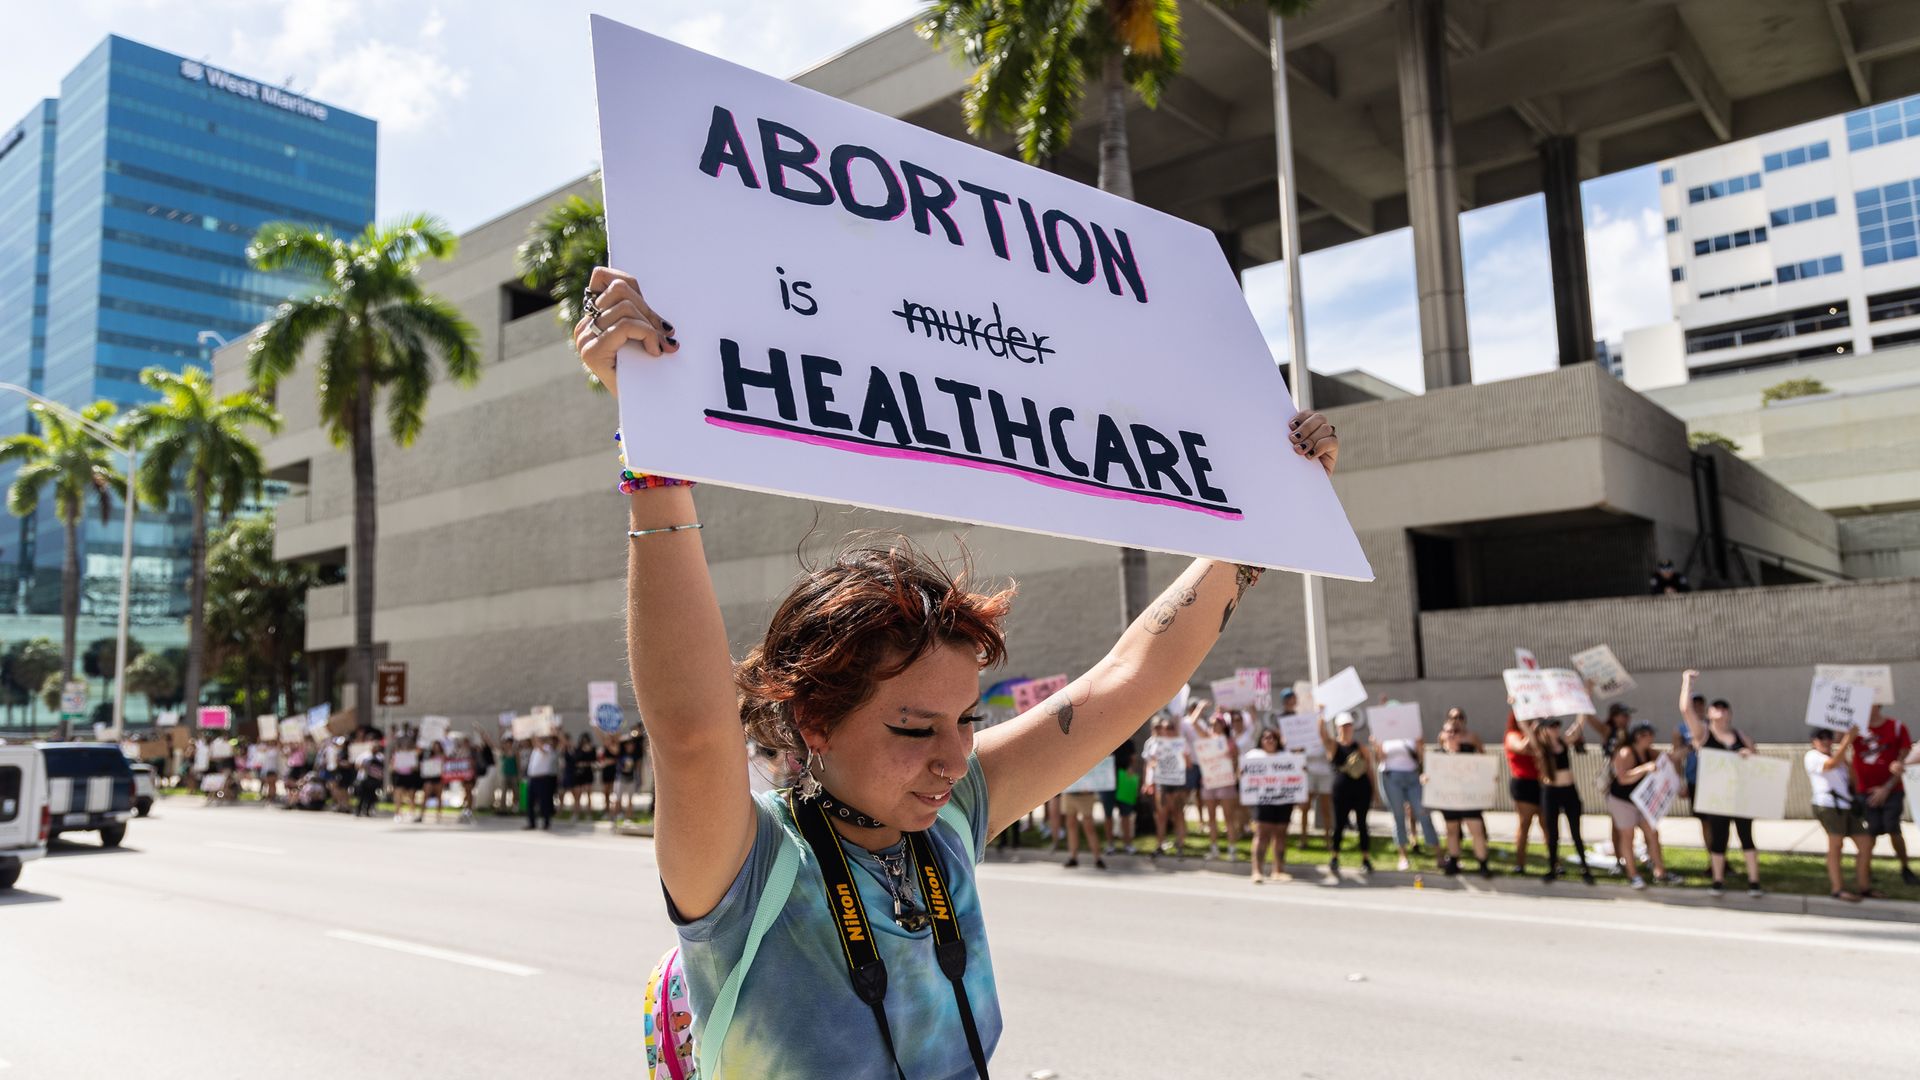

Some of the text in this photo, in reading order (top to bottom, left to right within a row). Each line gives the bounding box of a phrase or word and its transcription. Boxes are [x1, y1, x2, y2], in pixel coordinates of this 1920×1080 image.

[205, 66, 328, 121] West Marine
[698, 105, 1149, 304] ABORTION
[775, 266, 1055, 365] is murder
[719, 338, 1229, 504] HEALTHCARE
[836, 883, 865, 941] Nikon
[925, 866, 950, 921] Nikon
